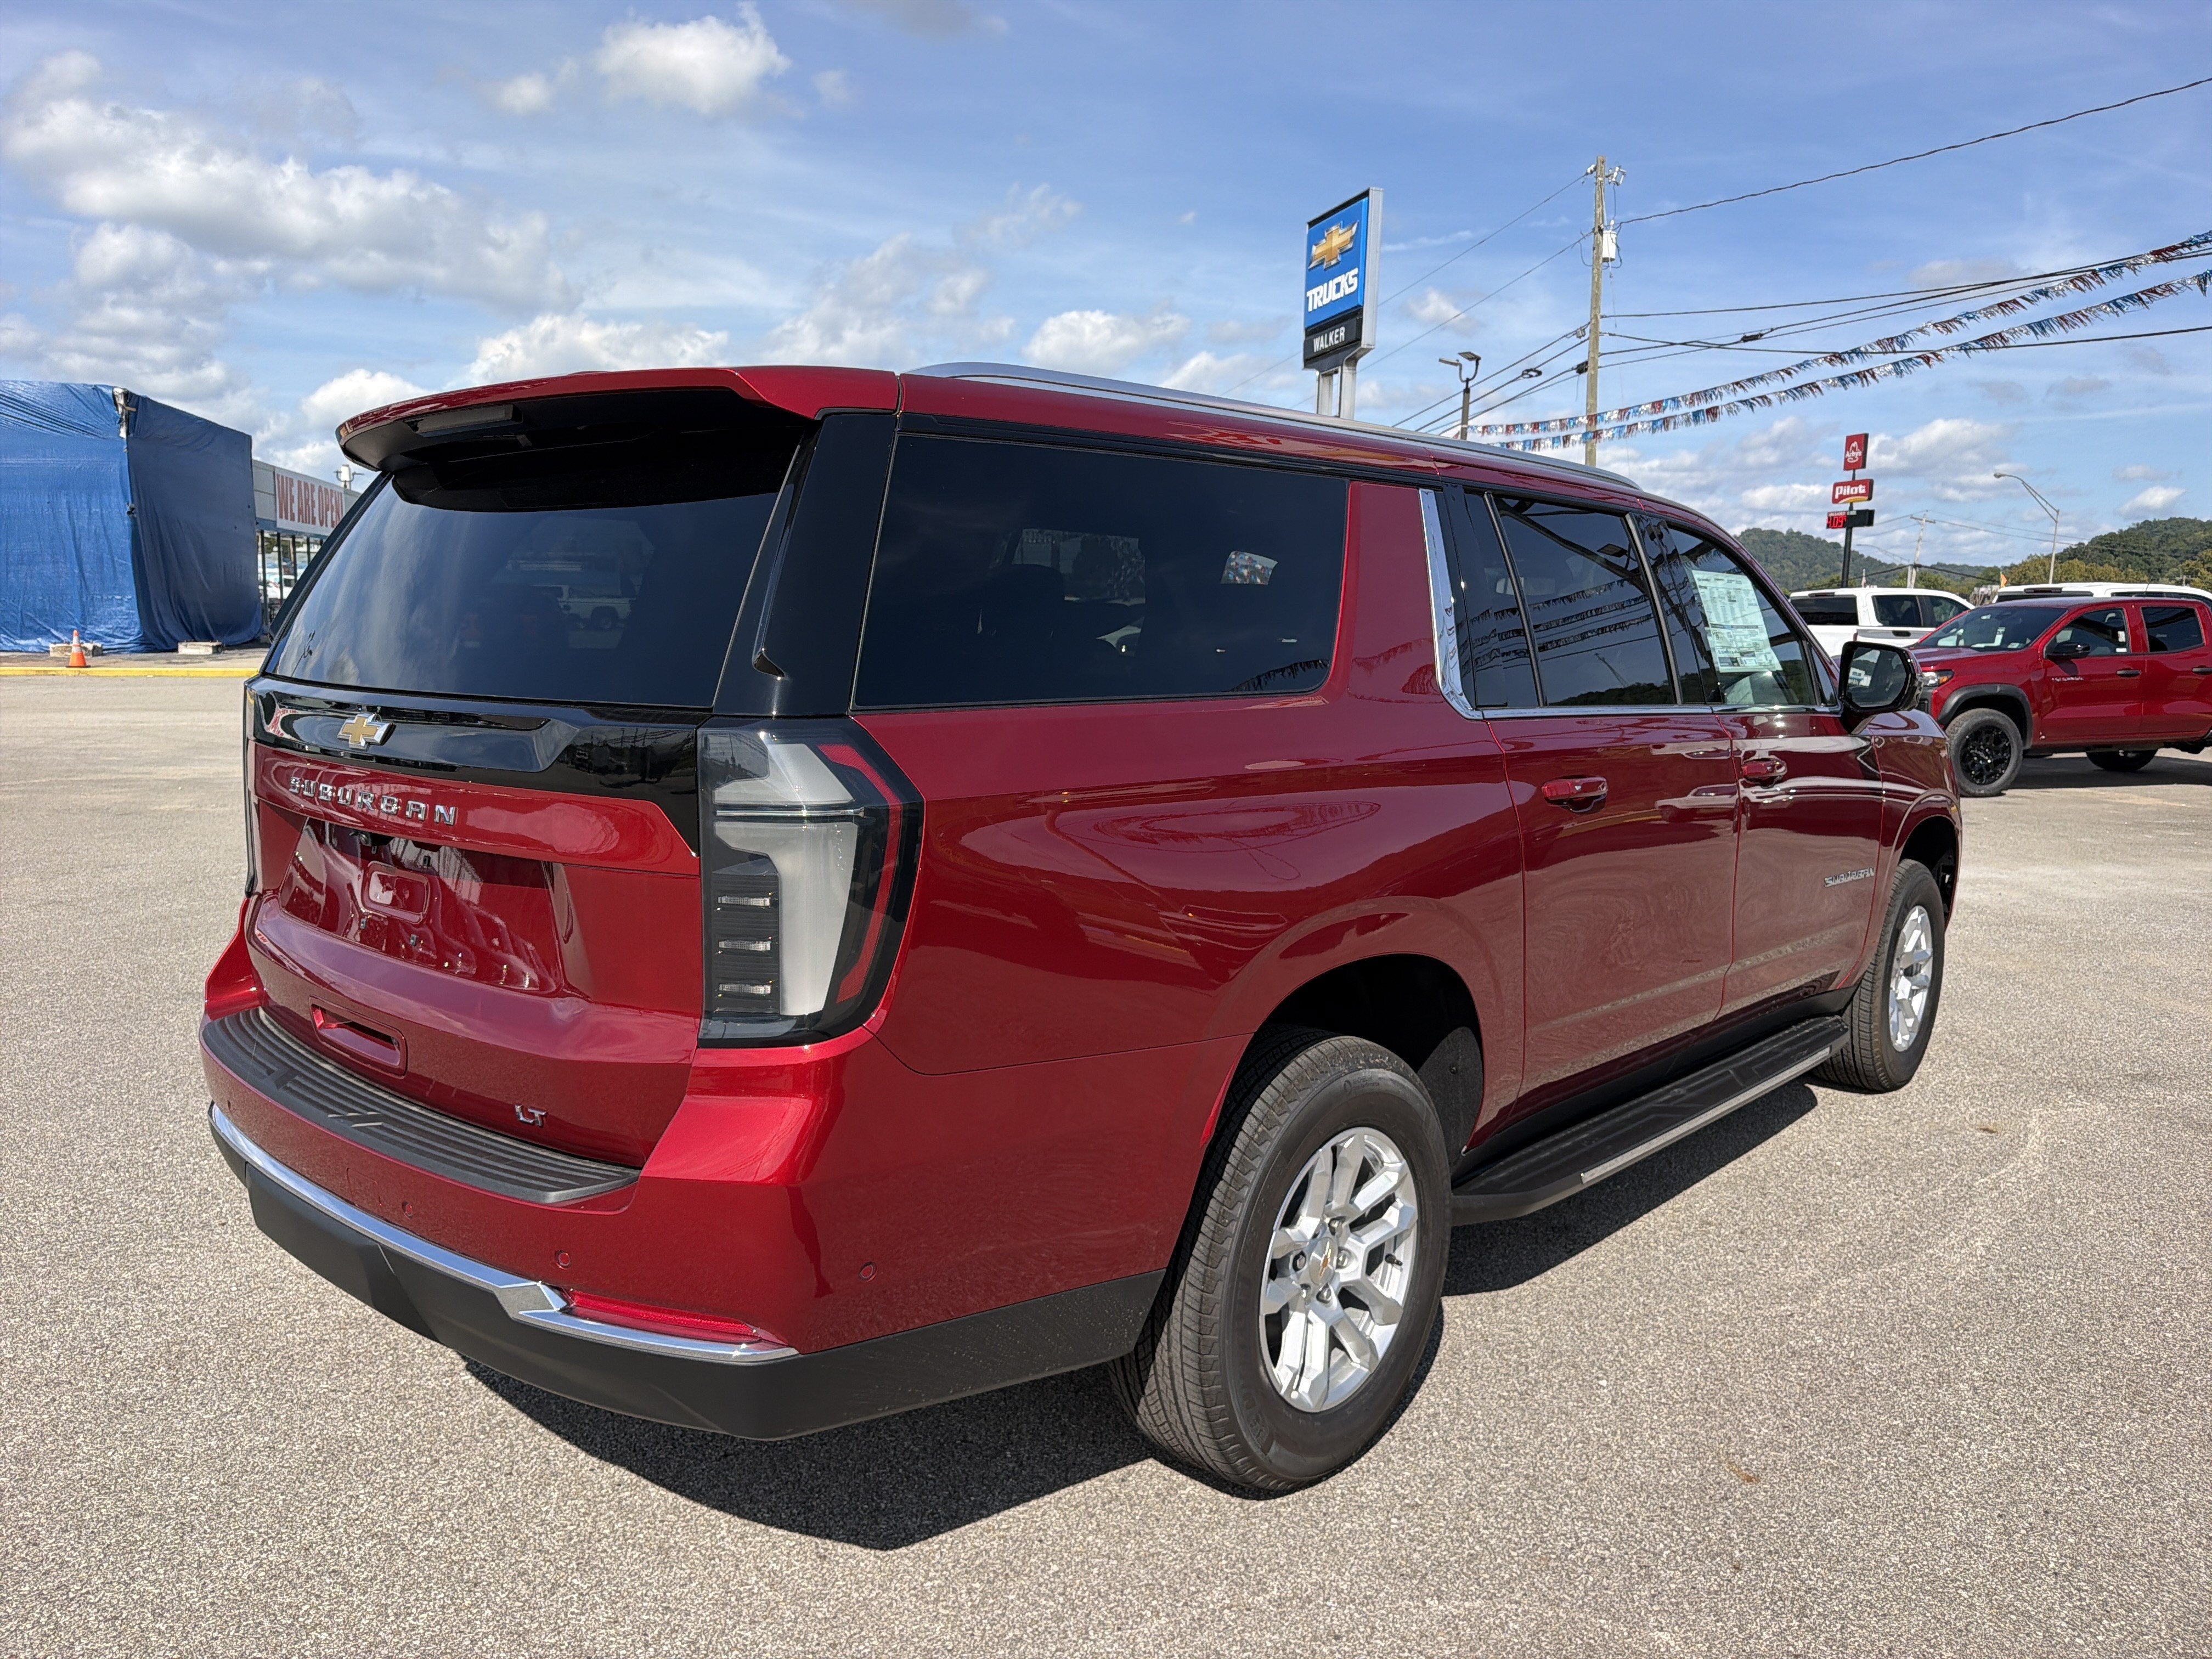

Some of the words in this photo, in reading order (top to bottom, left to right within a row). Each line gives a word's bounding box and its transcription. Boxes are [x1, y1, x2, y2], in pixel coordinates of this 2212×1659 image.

[1306, 268, 1358, 312] TRUCKS
[1313, 326, 1345, 353] WALKER
[276, 473, 295, 521] WE
[297, 479, 316, 525] ARE
[1835, 484, 1866, 499] Pilot
[289, 776, 457, 825] SUBURBAN
[515, 1103, 548, 1127] LT
